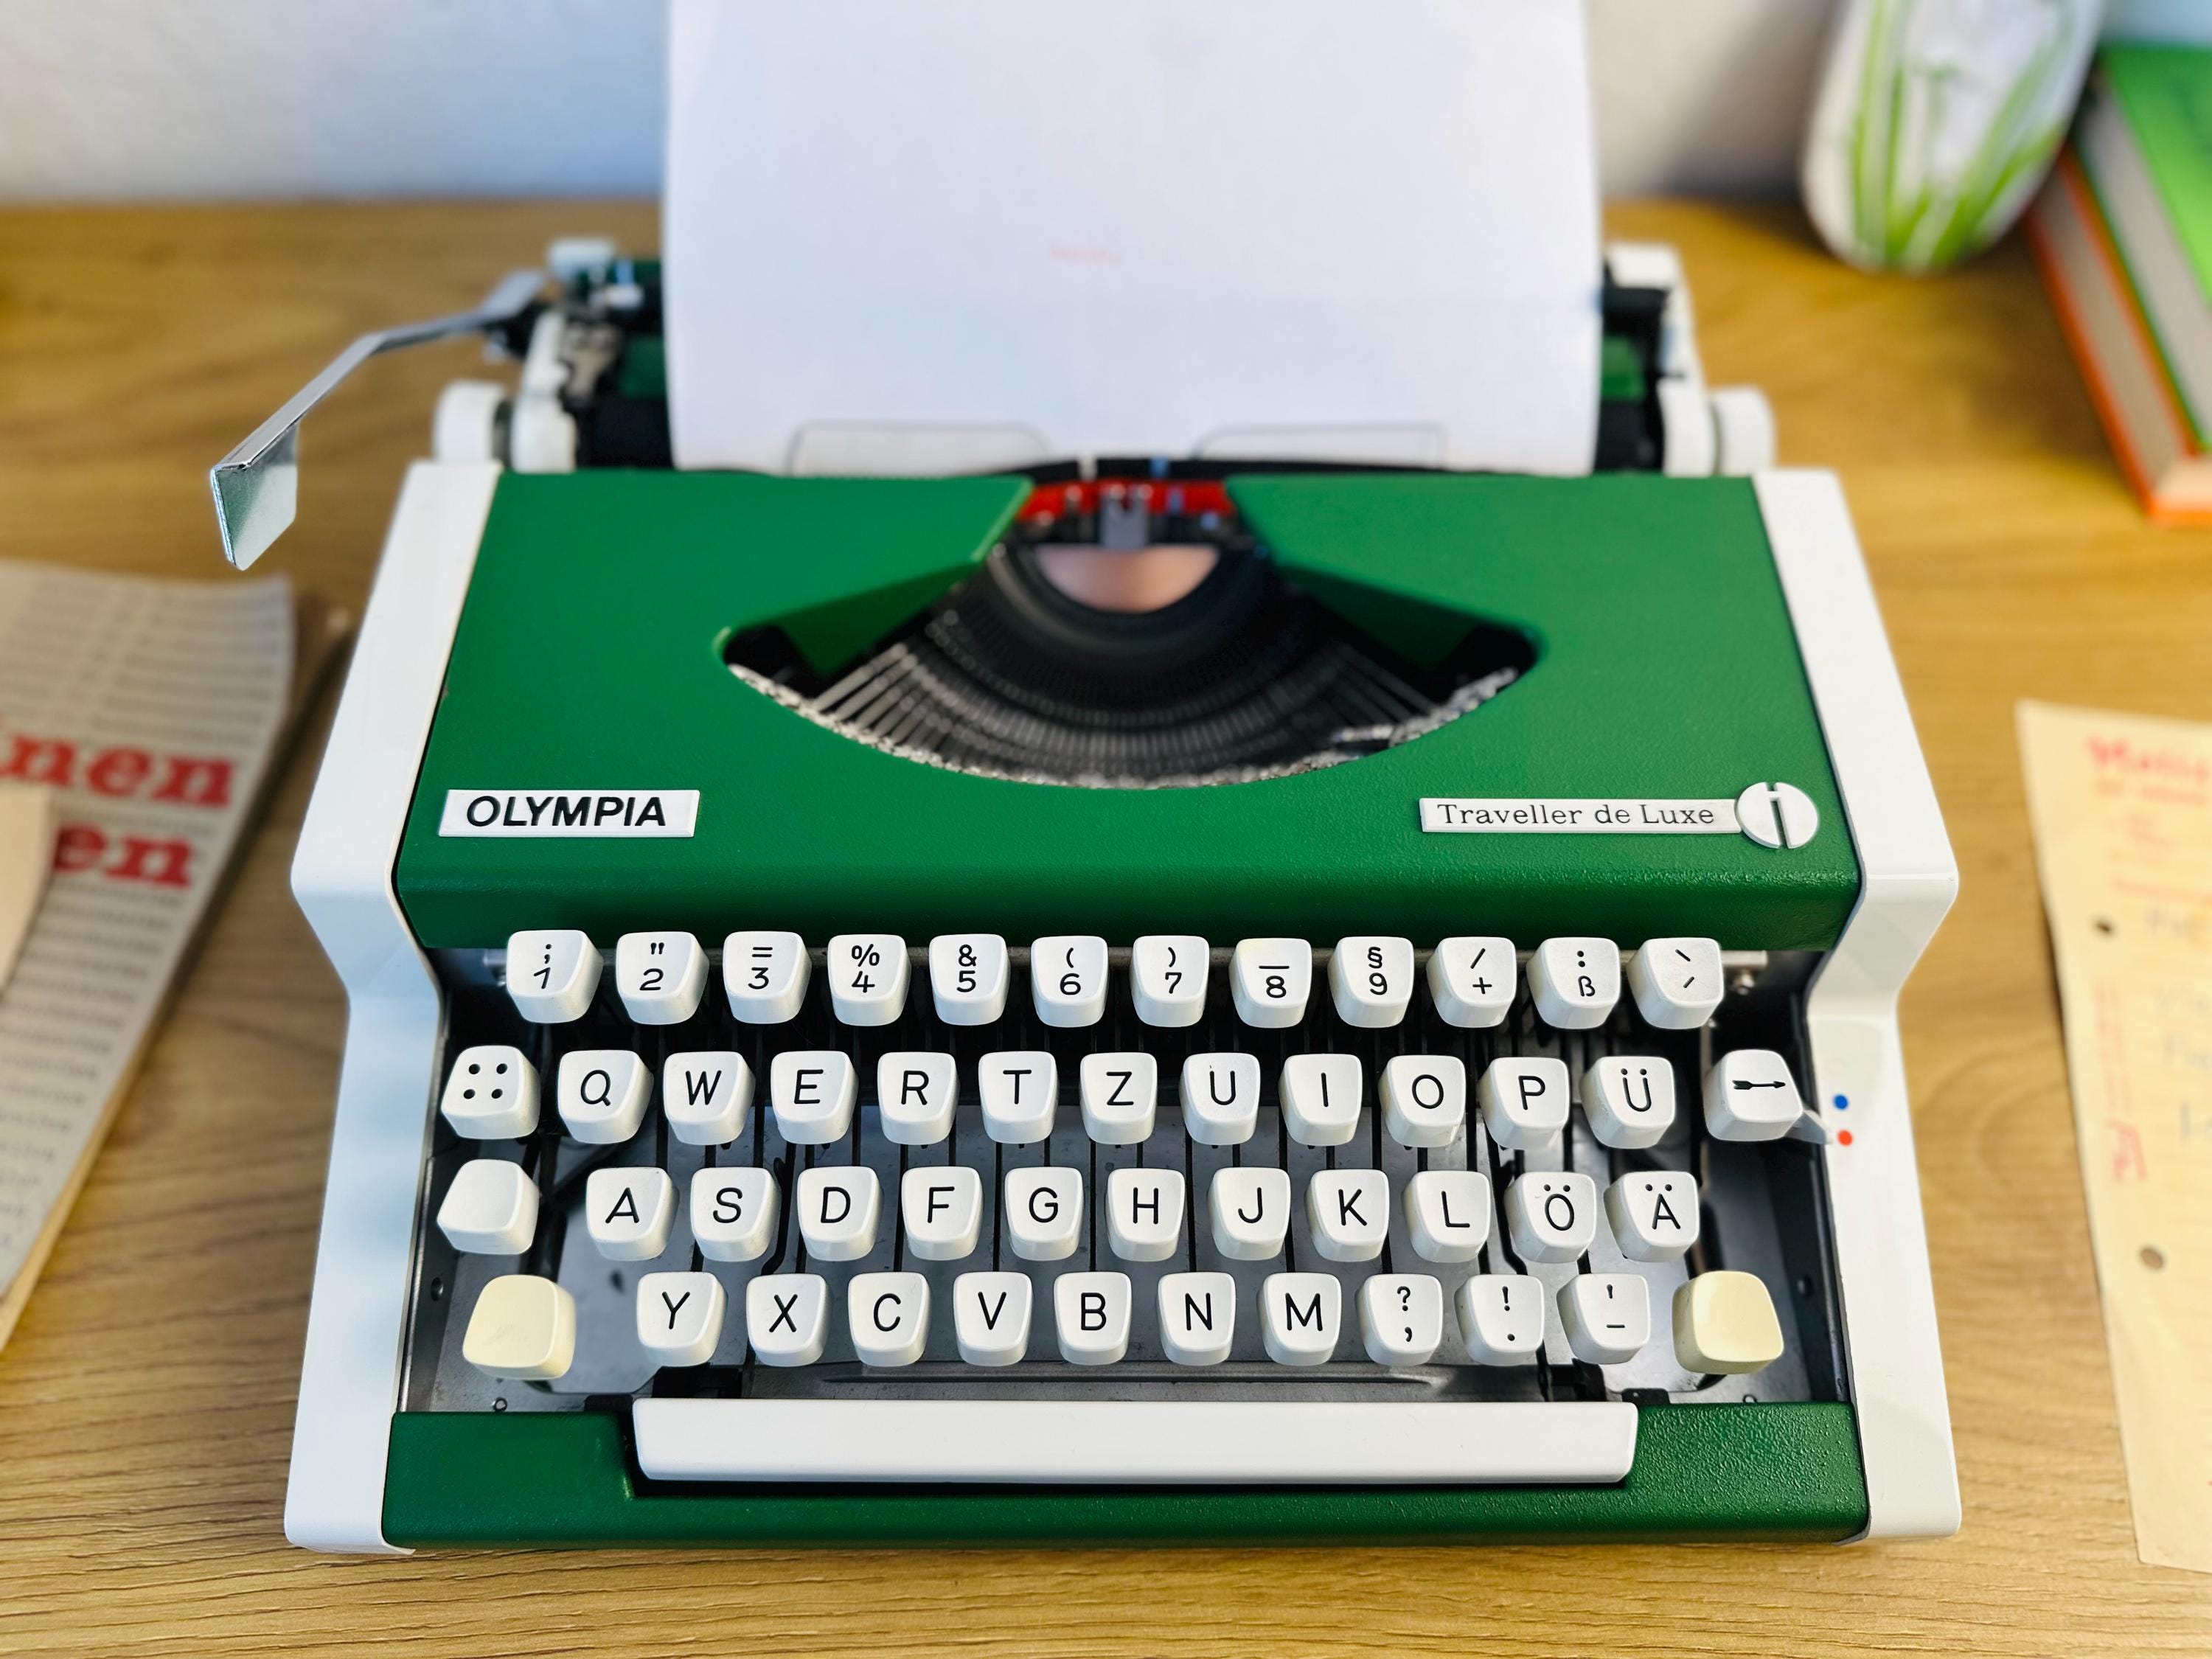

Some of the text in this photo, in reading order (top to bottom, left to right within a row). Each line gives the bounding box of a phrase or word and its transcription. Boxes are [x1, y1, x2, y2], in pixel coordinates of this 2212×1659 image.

[466, 795, 666, 827] OLYMPIA
[1437, 804, 1714, 824] Traveller de Luxe
[851, 943, 880, 967] %
[958, 944, 977, 967] &
[1367, 946, 1383, 969] §
[533, 967, 551, 990] 1
[639, 968, 664, 991] 2
[748, 967, 770, 990] 3
[851, 970, 876, 993] 4
[956, 970, 976, 993] 5
[1060, 973, 1082, 995] 6
[1164, 972, 1183, 995] 7
[1265, 975, 1287, 999] 8
[1368, 972, 1388, 995] 9
[580, 1069, 611, 1107] Q
[685, 1070, 722, 1106] W
[793, 1068, 824, 1105] E
[900, 1070, 930, 1106] R
[1002, 1069, 1032, 1105] T
[1105, 1071, 1134, 1106] Z
[1209, 1070, 1237, 1106] U
[1411, 1074, 1444, 1110] O
[1518, 1075, 1546, 1110] P
[1621, 1068, 1652, 1113] Ü
[605, 1183, 1681, 1231] A S D F G H J K L Ö Ä
[661, 1291, 691, 1330] Y
[768, 1293, 799, 1333] X
[873, 1293, 902, 1332] C
[977, 1291, 1007, 1331] V
[1080, 1292, 1107, 1331] B
[1185, 1293, 1213, 1331] N
[1284, 1293, 1324, 1332] M
[1397, 1286, 1411, 1312] ?
